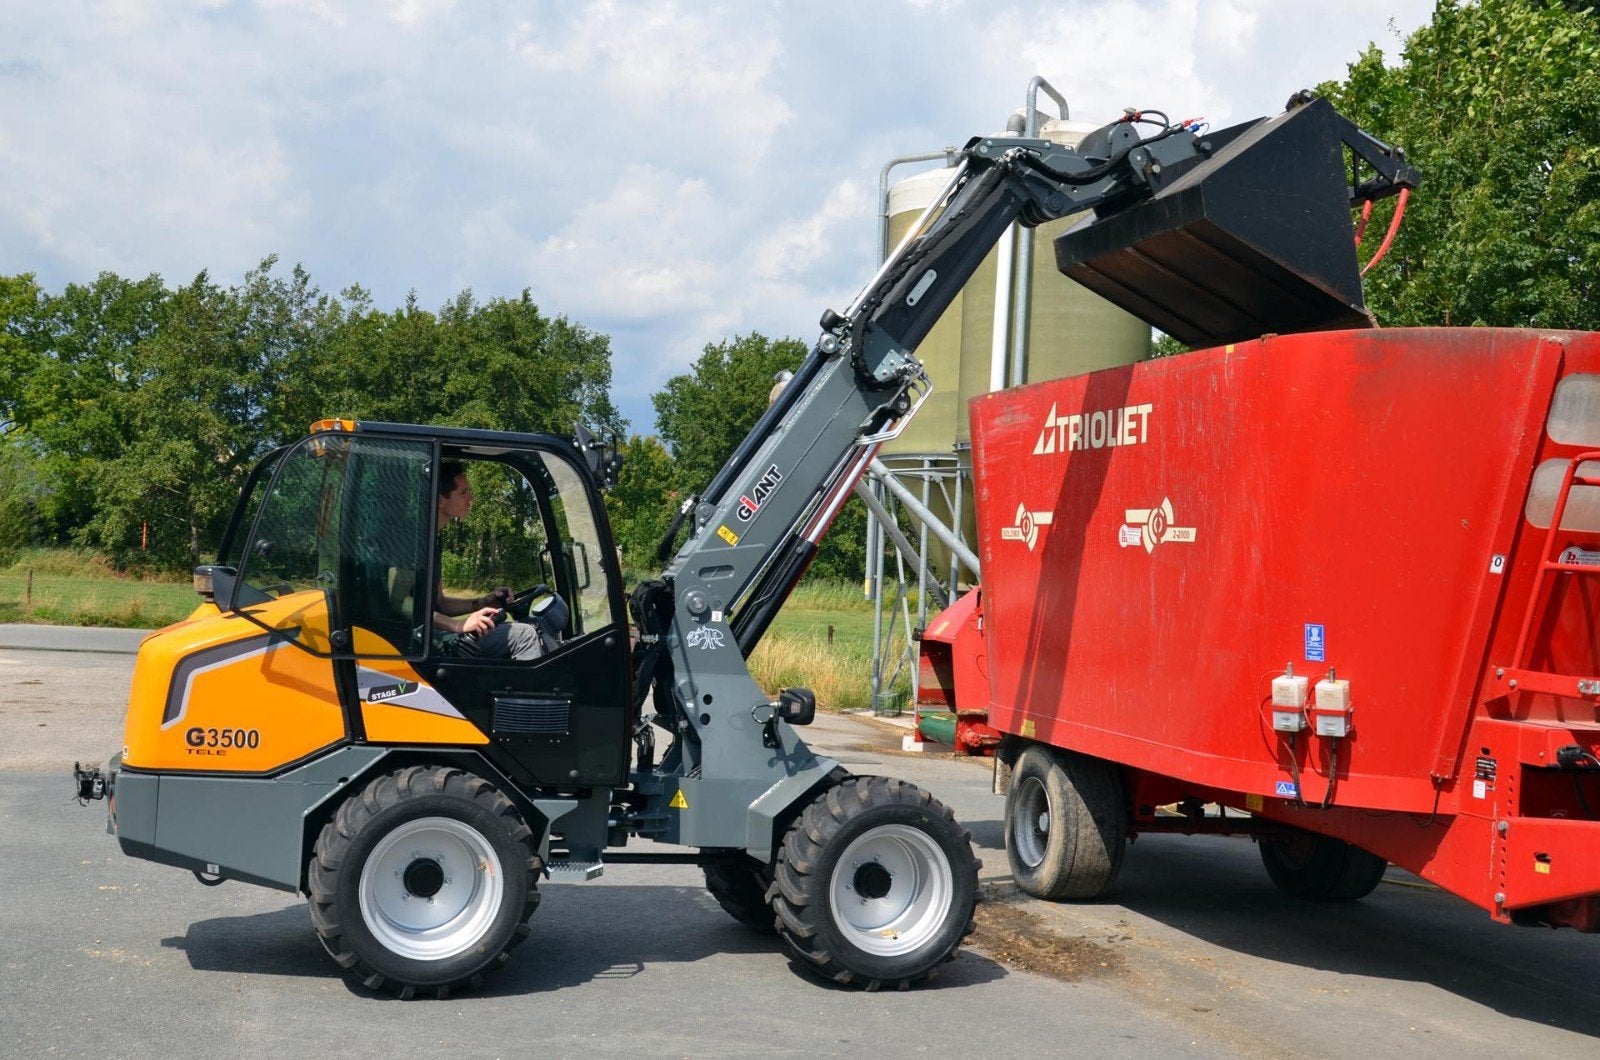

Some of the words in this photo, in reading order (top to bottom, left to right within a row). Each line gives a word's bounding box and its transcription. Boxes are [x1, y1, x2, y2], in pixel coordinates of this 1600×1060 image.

[1056, 403, 1153, 453] TRIOLIET
[371, 689, 397, 701] STAGE
[185, 727, 259, 749] G3500
[185, 748, 227, 756] TELE
